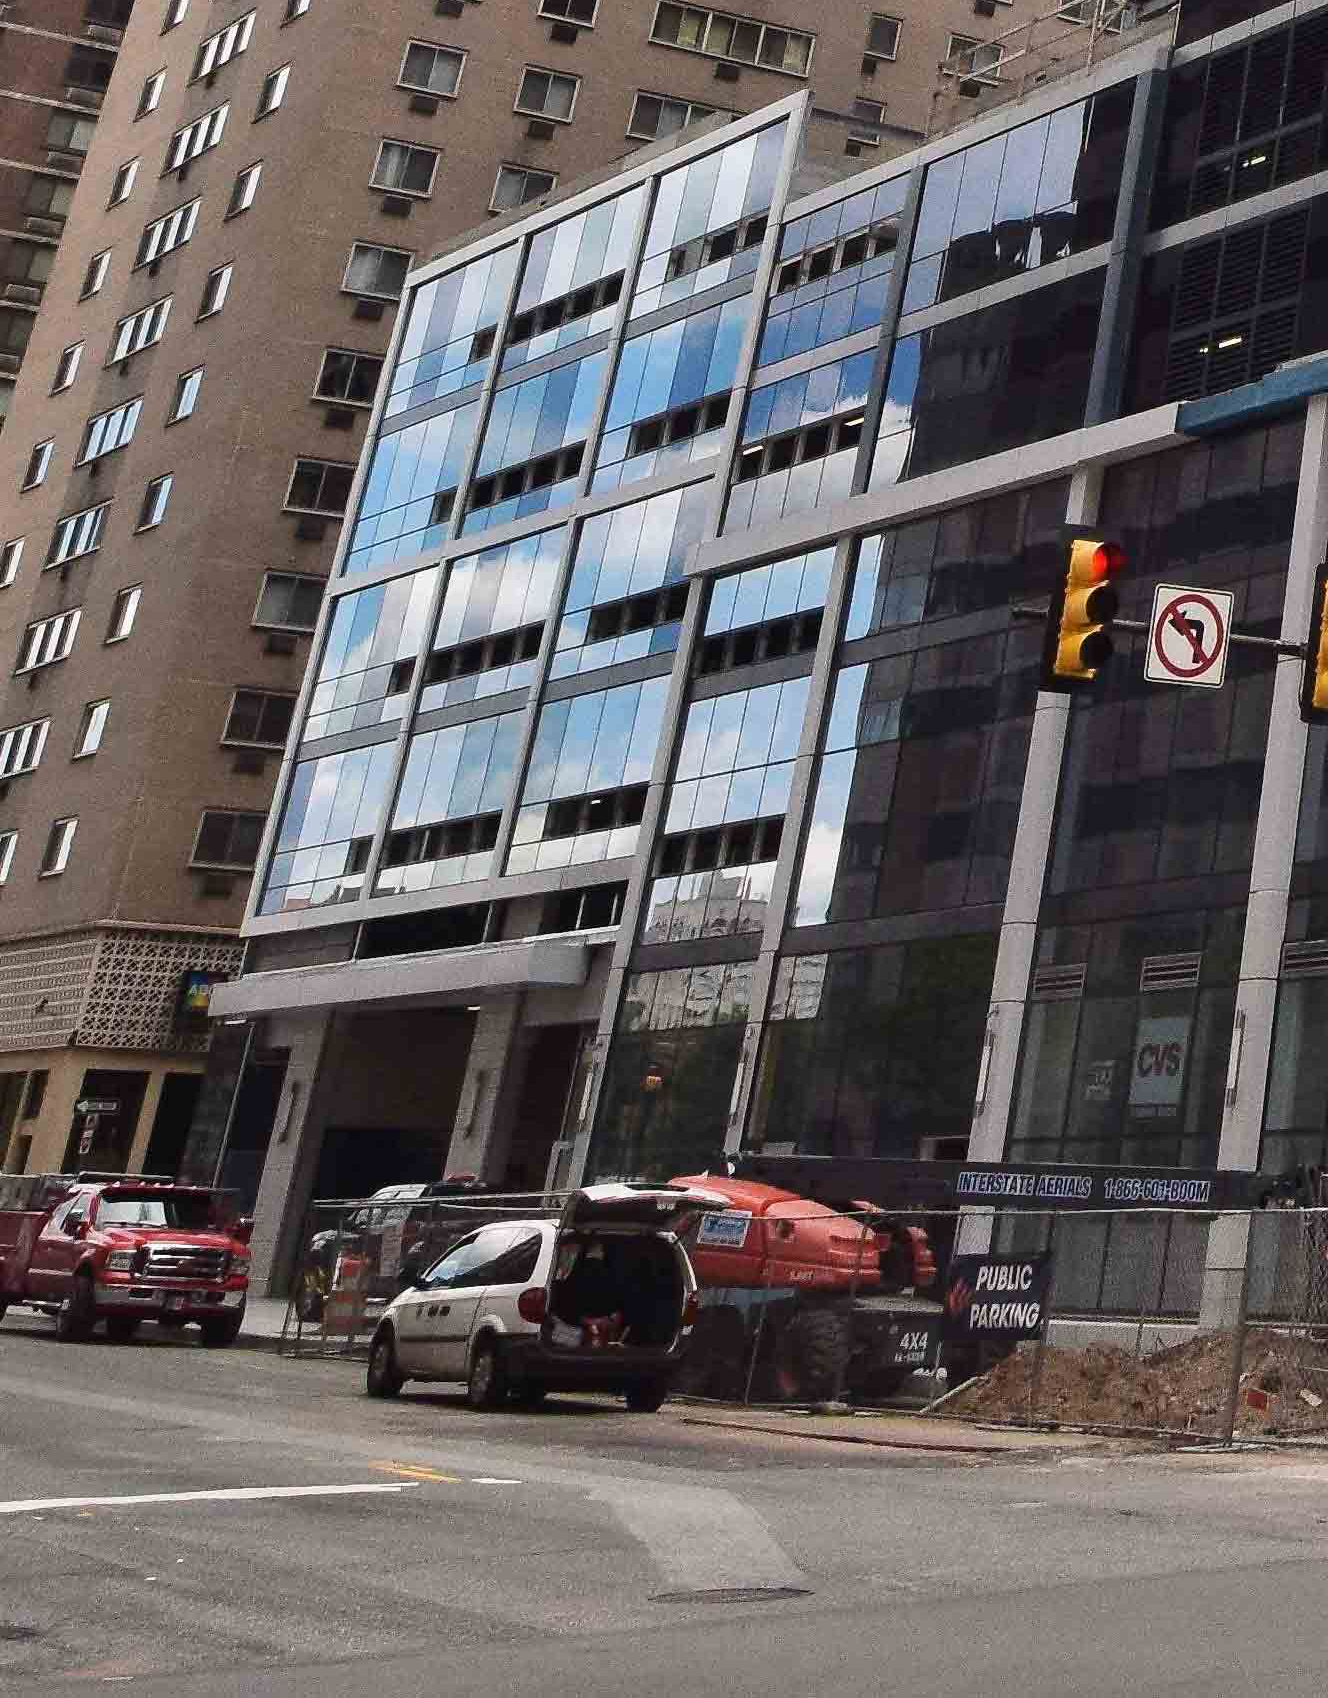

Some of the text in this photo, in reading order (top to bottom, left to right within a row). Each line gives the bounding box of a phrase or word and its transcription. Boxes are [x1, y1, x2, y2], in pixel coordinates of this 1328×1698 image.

[1137, 1042, 1184, 1078] CVS
[956, 1171, 1036, 1195] INTERSTATE
[1036, 1174, 1093, 1198] AERIALS
[976, 1264, 1032, 1291] PUBLIC
[969, 1302, 1040, 1330] PARKING
[899, 1332, 928, 1350] 4X4
